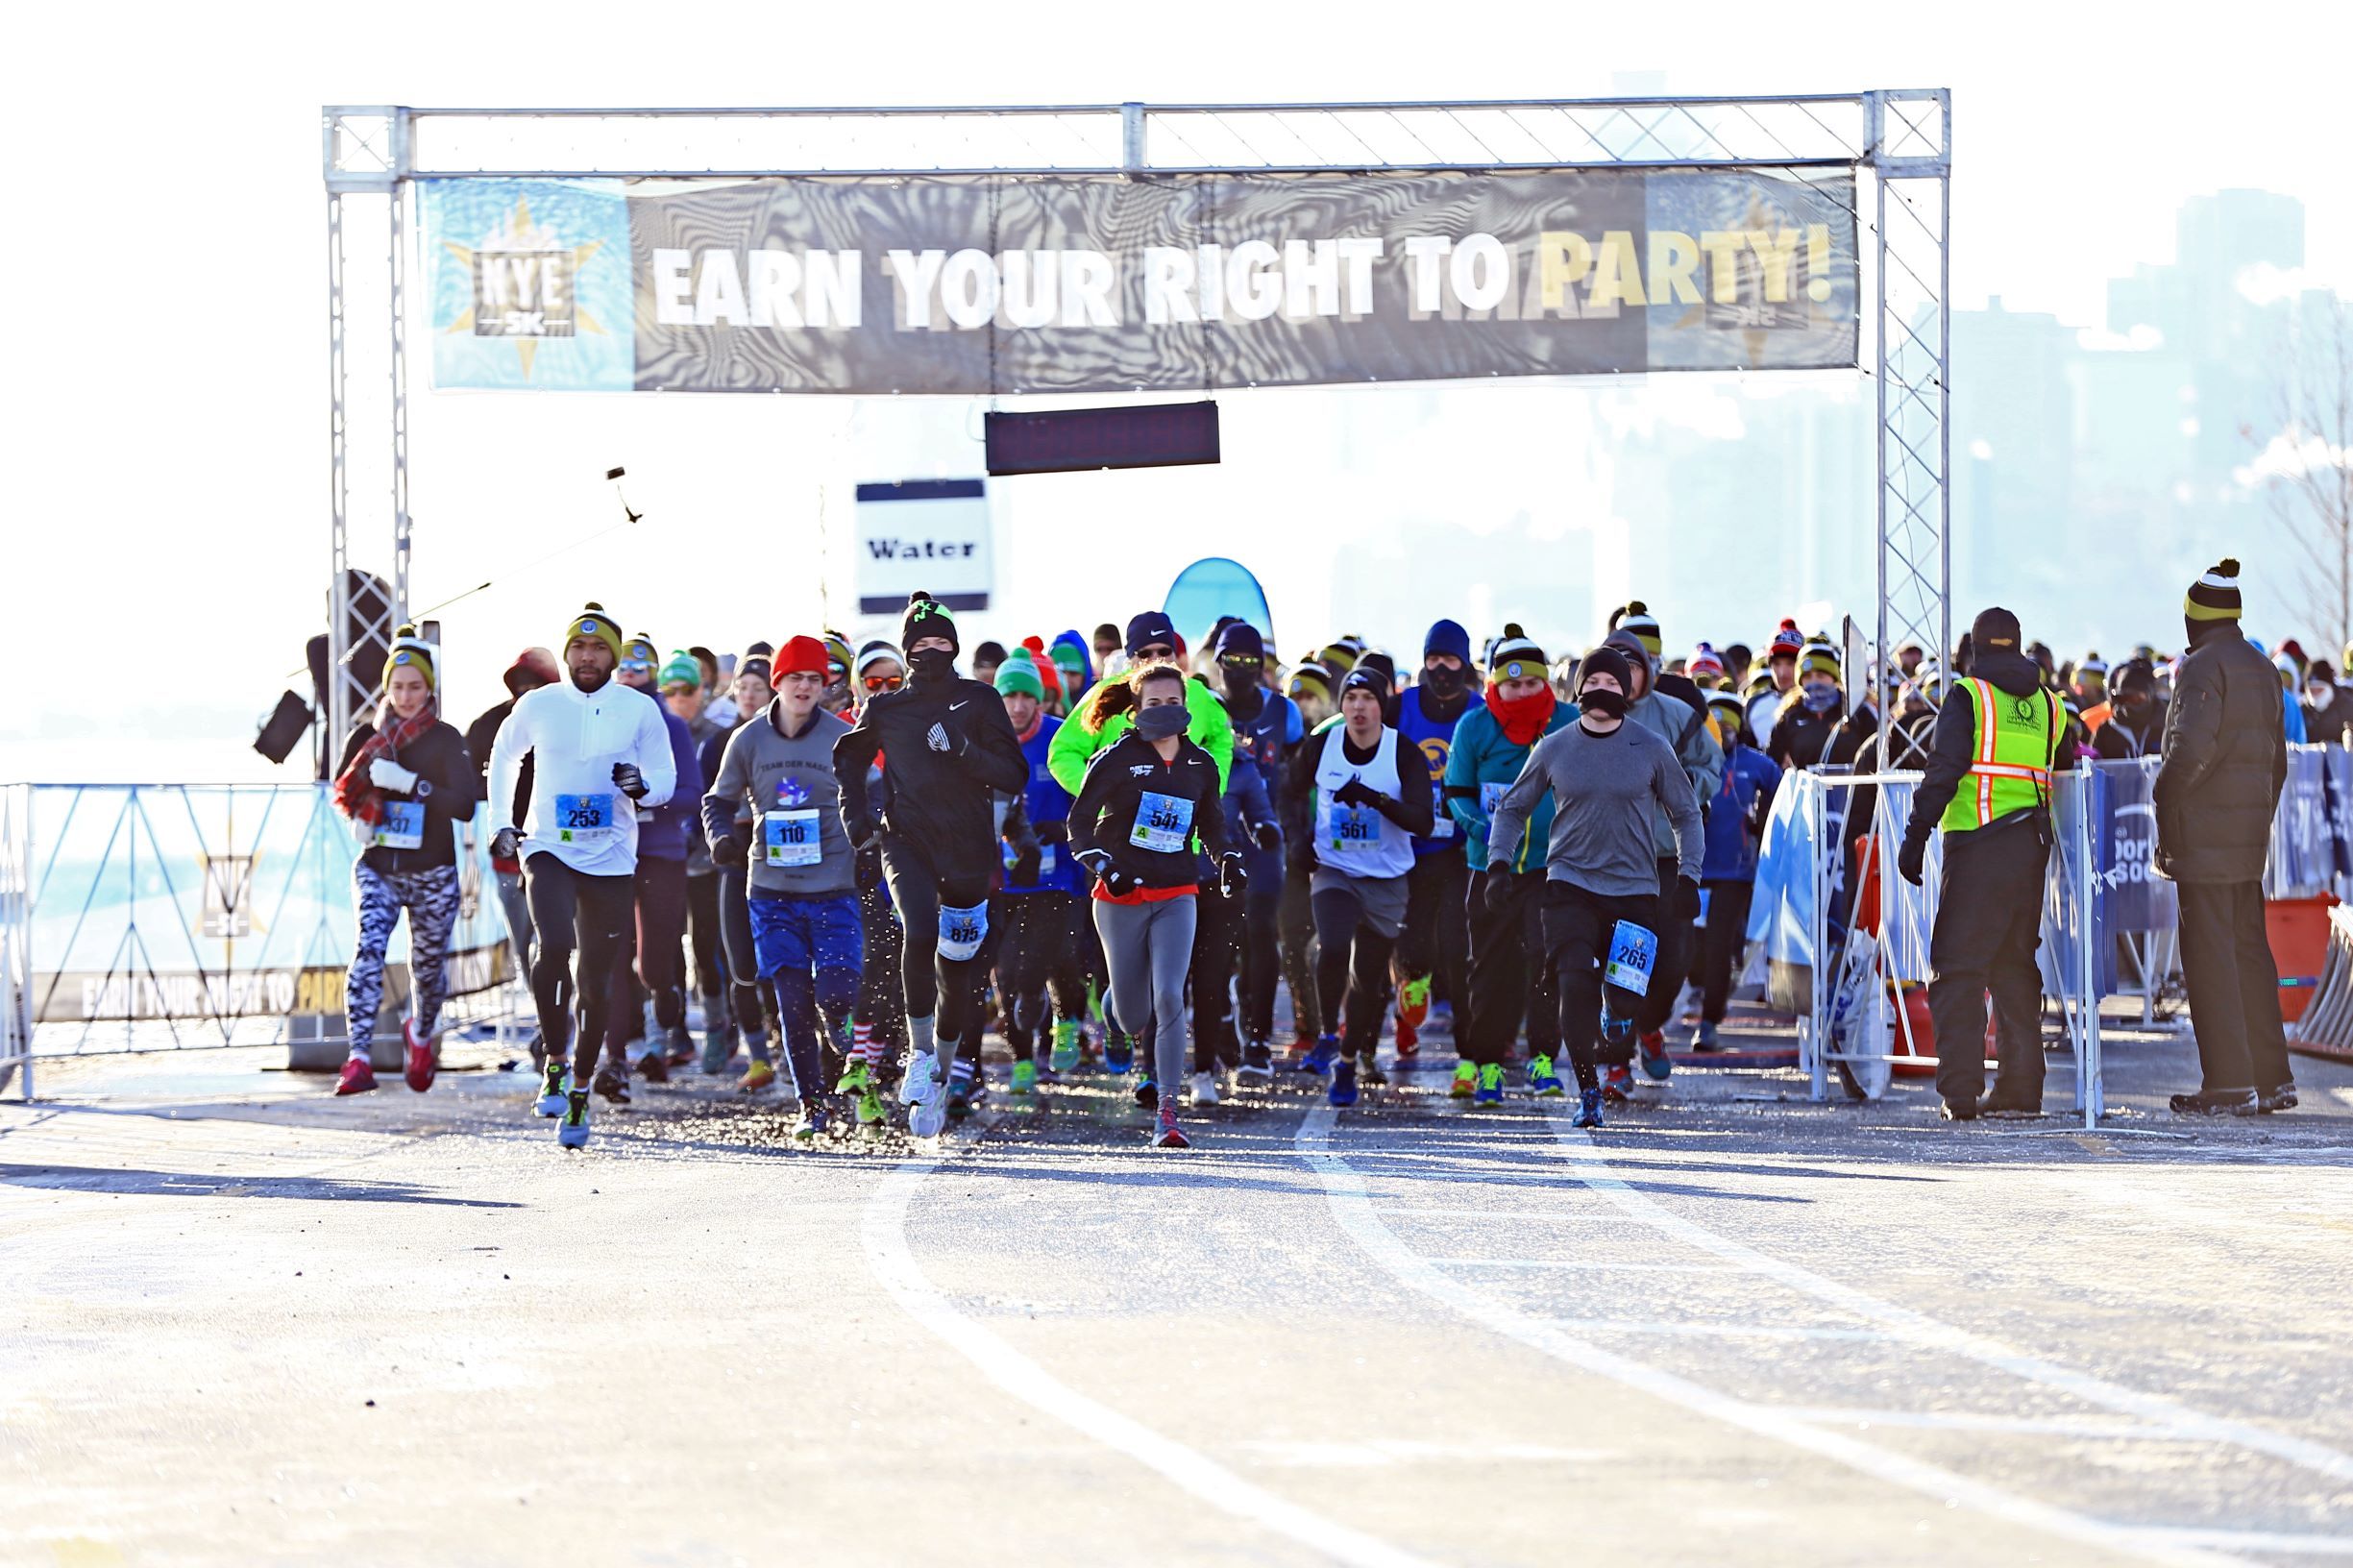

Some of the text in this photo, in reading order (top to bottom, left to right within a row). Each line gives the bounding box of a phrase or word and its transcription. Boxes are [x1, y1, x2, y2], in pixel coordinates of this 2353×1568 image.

[480, 256, 564, 308] NYE
[652, 223, 1831, 329] EARN YOUR RIGHT TO PARTY!
[505, 310, 544, 335] 5K
[869, 540, 973, 559] Water
[568, 809, 601, 827] 253
[1150, 810, 1179, 830] 541
[779, 825, 805, 844] 110
[1137, 827, 1147, 839] A
[1340, 822, 1367, 839] 561
[952, 926, 978, 943] 875
[1617, 945, 1648, 970] 265
[267, 972, 295, 1014] TO
